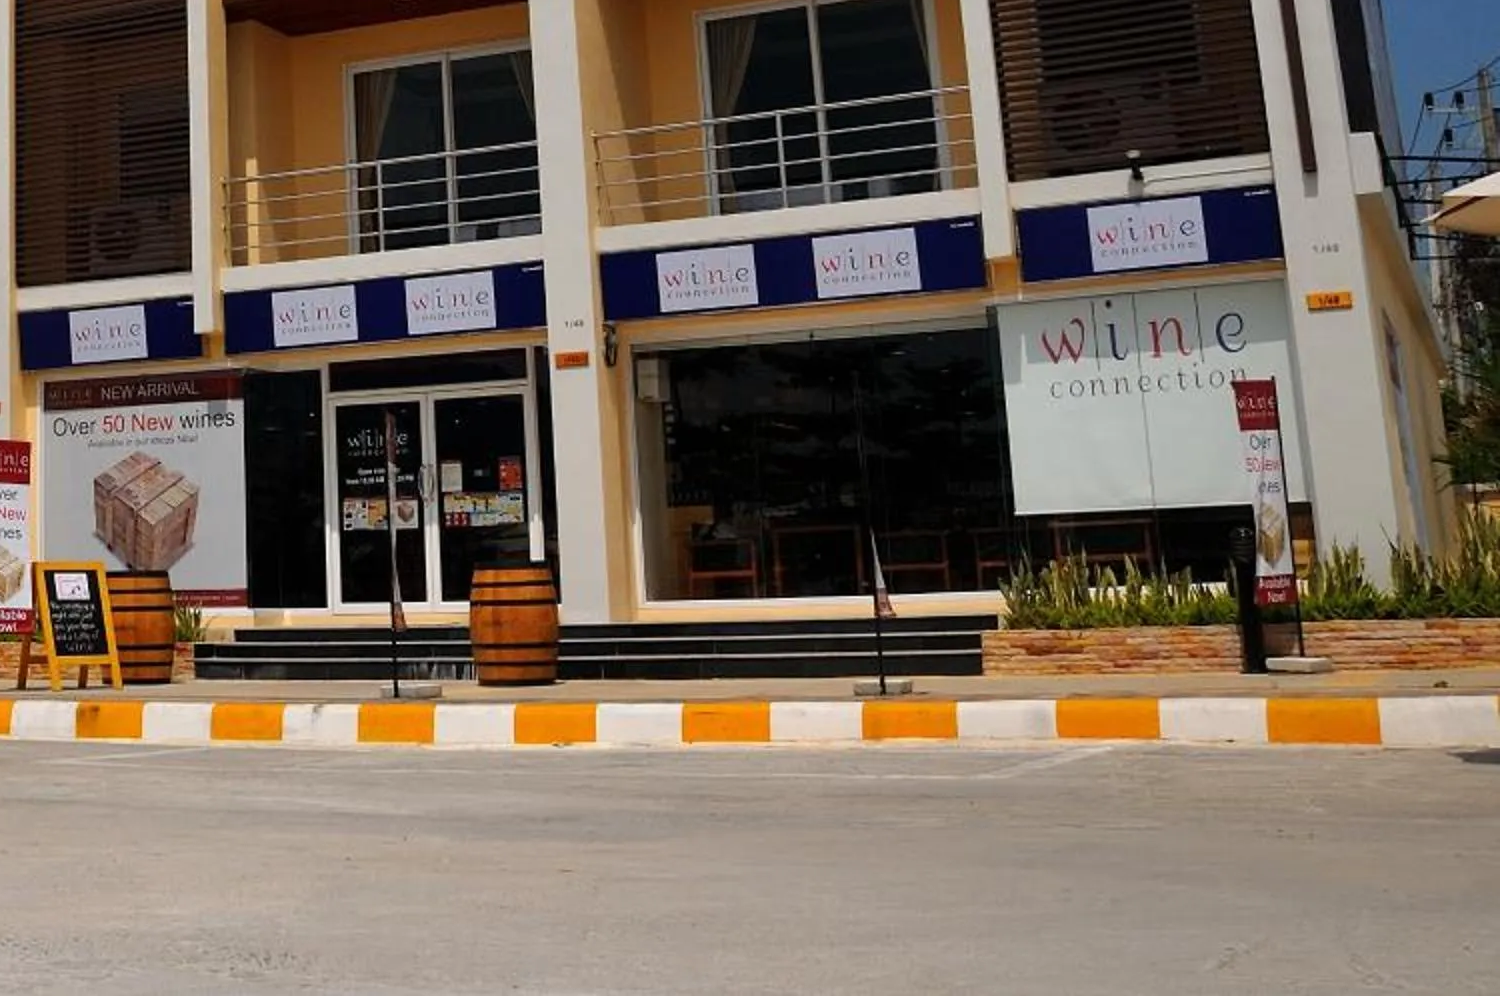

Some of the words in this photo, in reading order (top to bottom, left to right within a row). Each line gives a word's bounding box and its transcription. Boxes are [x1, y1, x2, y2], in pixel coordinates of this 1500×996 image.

[1095, 216, 1197, 245] wine
[821, 247, 910, 275] wine
[663, 263, 749, 289] wine
[411, 287, 489, 311] wine
[278, 301, 351, 325] wine
[75, 318, 141, 342] wine
[1041, 299, 1247, 364] wine
[101, 386, 133, 402] NEW
[136, 379, 199, 398] ARRIVAL
[1050, 362, 1248, 399] connection
[52, 416, 97, 438] Over
[102, 415, 125, 434] 50
[131, 412, 174, 433] New
[179, 408, 236, 430] wines
[347, 429, 408, 447] wie
